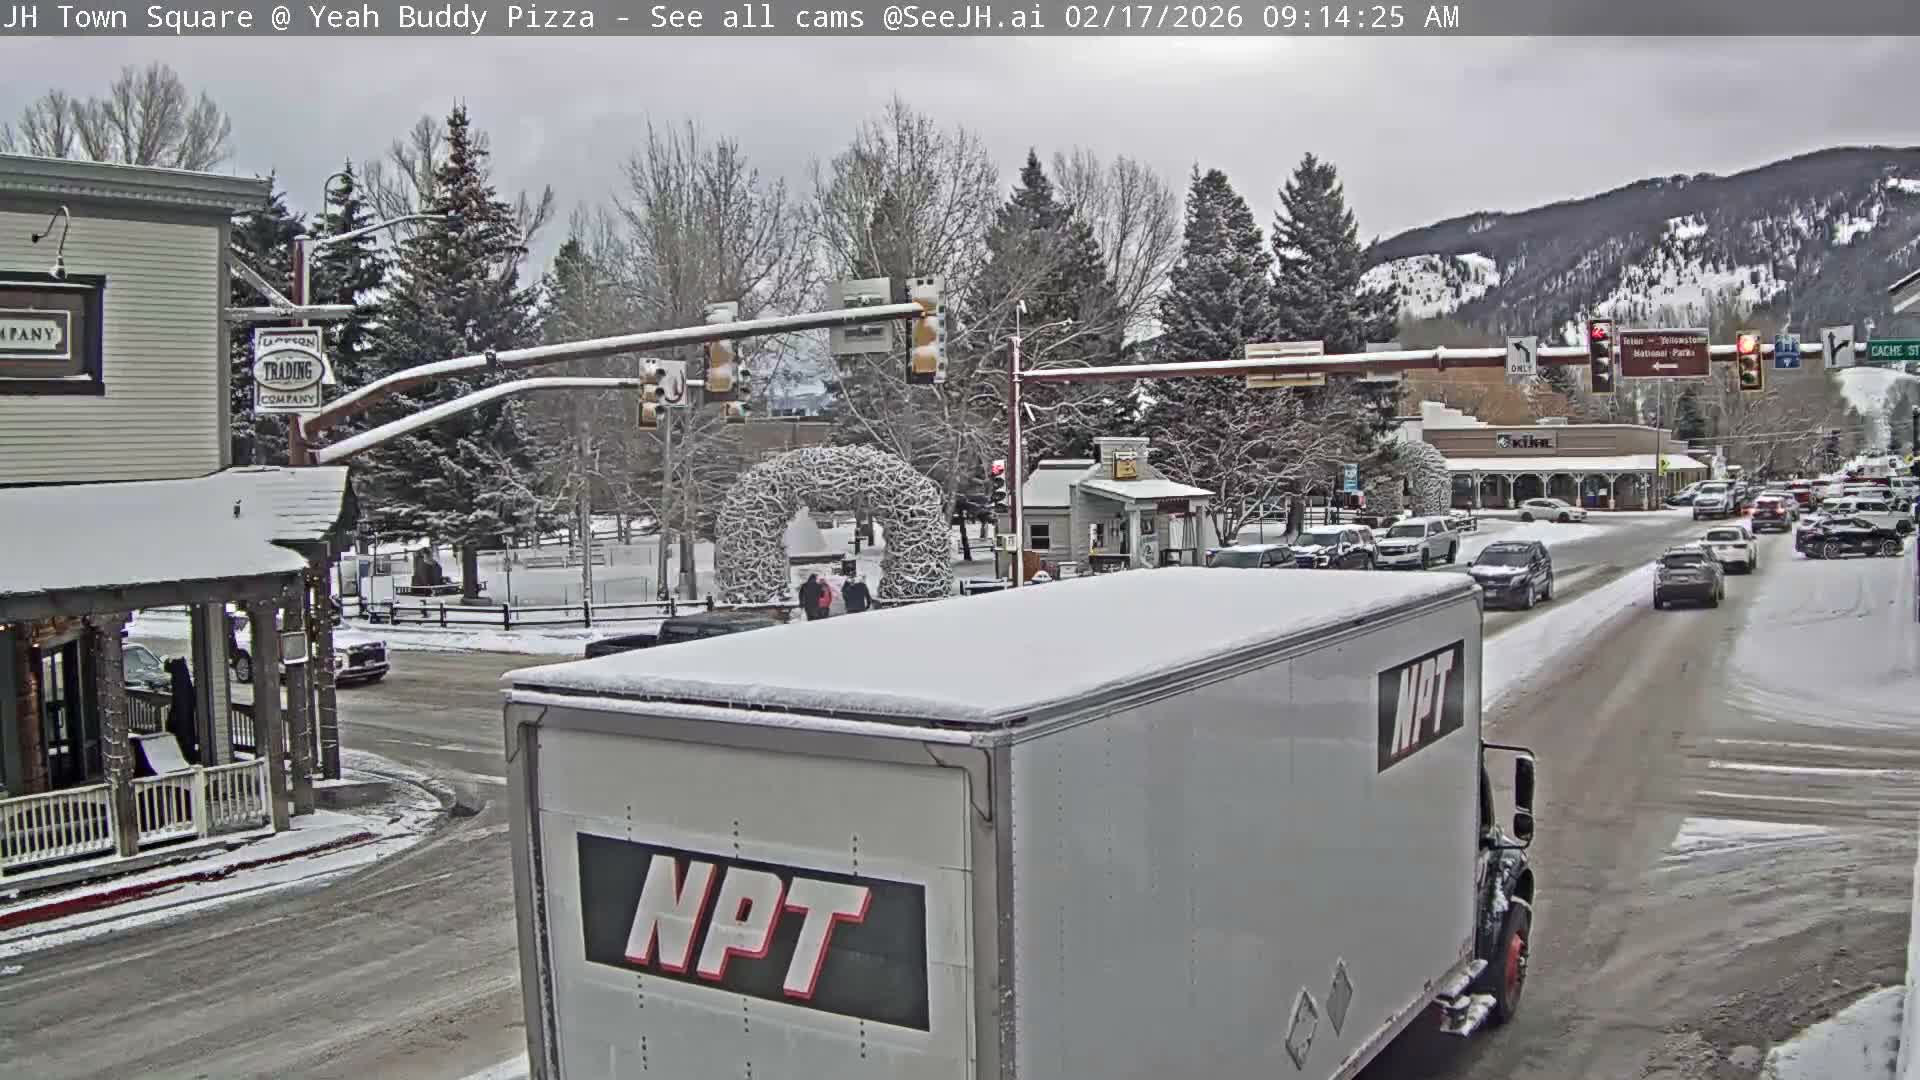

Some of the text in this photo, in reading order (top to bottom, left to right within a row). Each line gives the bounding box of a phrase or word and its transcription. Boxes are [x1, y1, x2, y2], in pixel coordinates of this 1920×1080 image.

[1633, 348, 1668, 358] National
[1871, 344, 1903, 357] CACHE
[263, 360, 312, 381] TRADING
[1510, 364, 1532, 373] ONLY
[261, 394, 315, 405] COMPANY
[1391, 649, 1457, 759] NPT
[624, 854, 873, 1001] NPT
